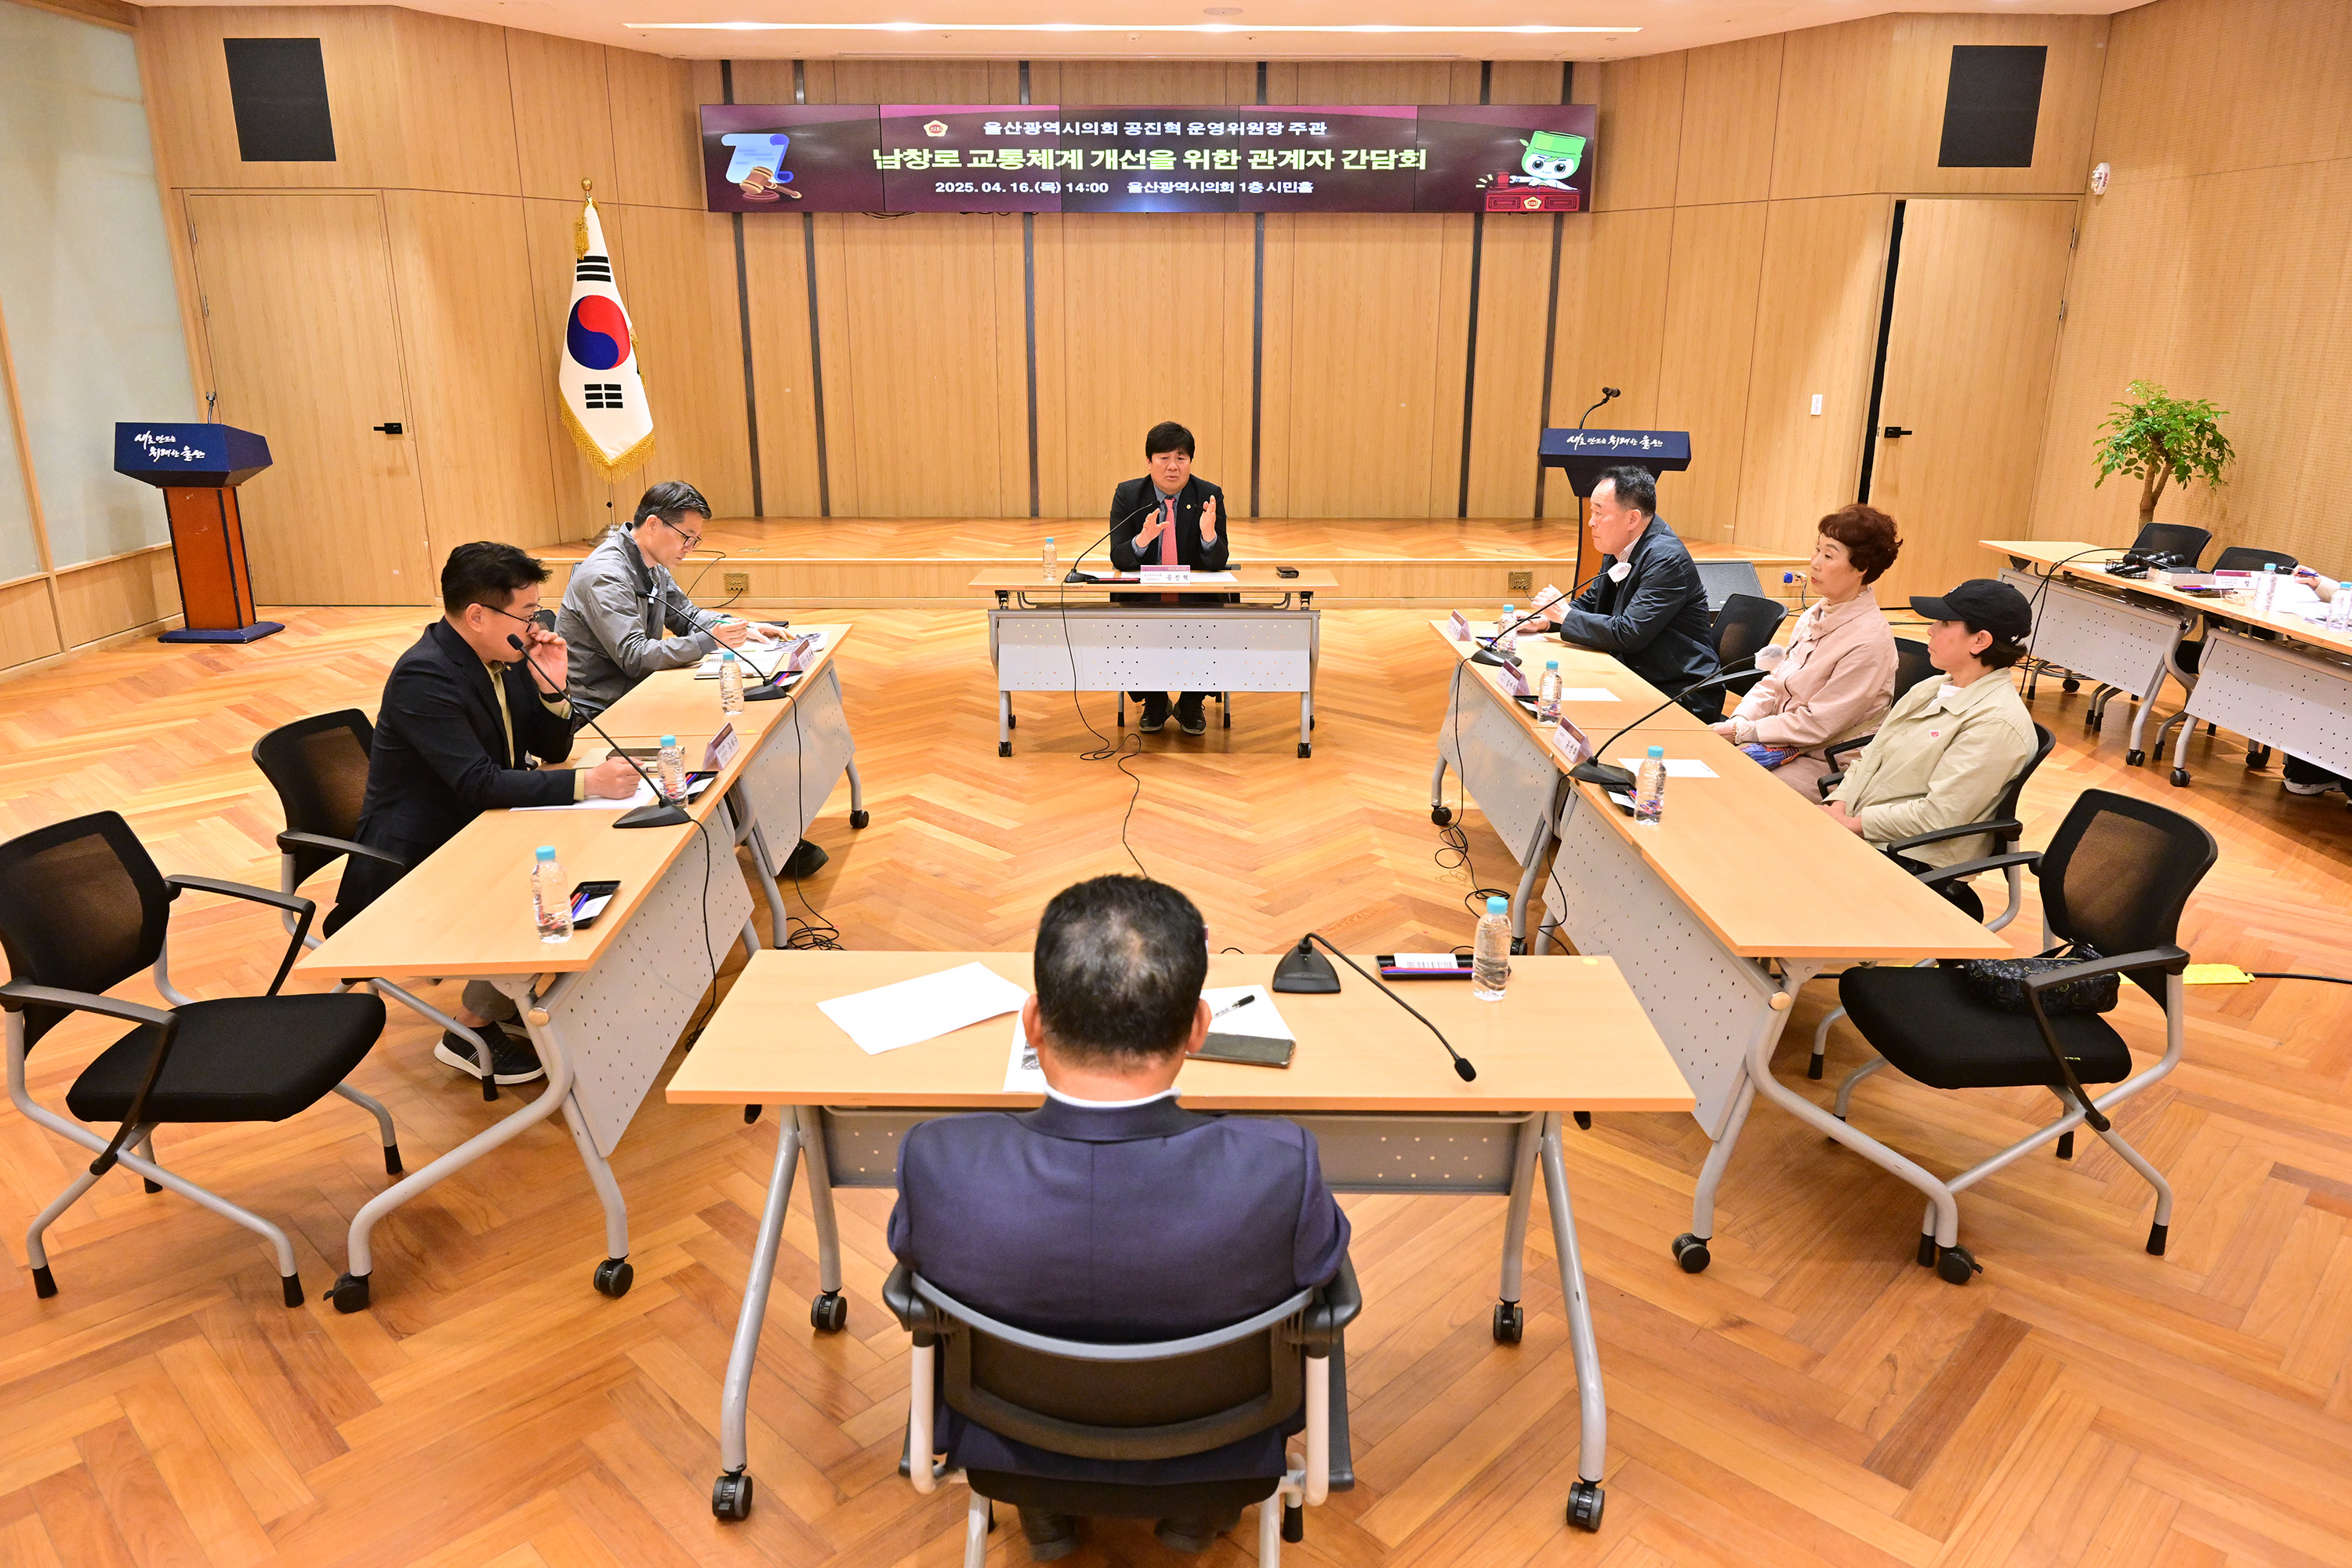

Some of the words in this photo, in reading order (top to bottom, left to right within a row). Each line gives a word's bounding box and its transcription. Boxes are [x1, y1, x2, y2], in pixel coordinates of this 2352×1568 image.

[983, 122, 1118, 136] 울산광역시의회
[1123, 122, 1181, 136] 공진혁
[1187, 122, 1284, 136] 운영위원장
[1288, 122, 1327, 136] 주관
[873, 148, 962, 170] 남창로
[967, 148, 1083, 170] 교통체계
[1090, 148, 1177, 170] 개선을
[1182, 149, 1241, 170] 위한
[1247, 149, 1335, 170] 관계자
[1341, 149, 1426, 170] 간담회
[935, 182, 978, 193] 2025.
[982, 182, 1007, 193] 04.
[1010, 181, 1061, 194] 16.(목)
[1065, 182, 1109, 193] 14:00
[1127, 181, 1235, 194] 울산광역시의회
[1239, 181, 1264, 194] 1층
[1266, 181, 1314, 194] 시민홀
[134, 430, 156, 450] 새로
[155, 435, 176, 444] 만드는
[1566, 433, 1587, 451] 새로
[1607, 434, 1638, 451] 위대한
[1639, 434, 1664, 450] 울산
[148, 445, 180, 463] 위대한
[180, 445, 205, 462] 울산
